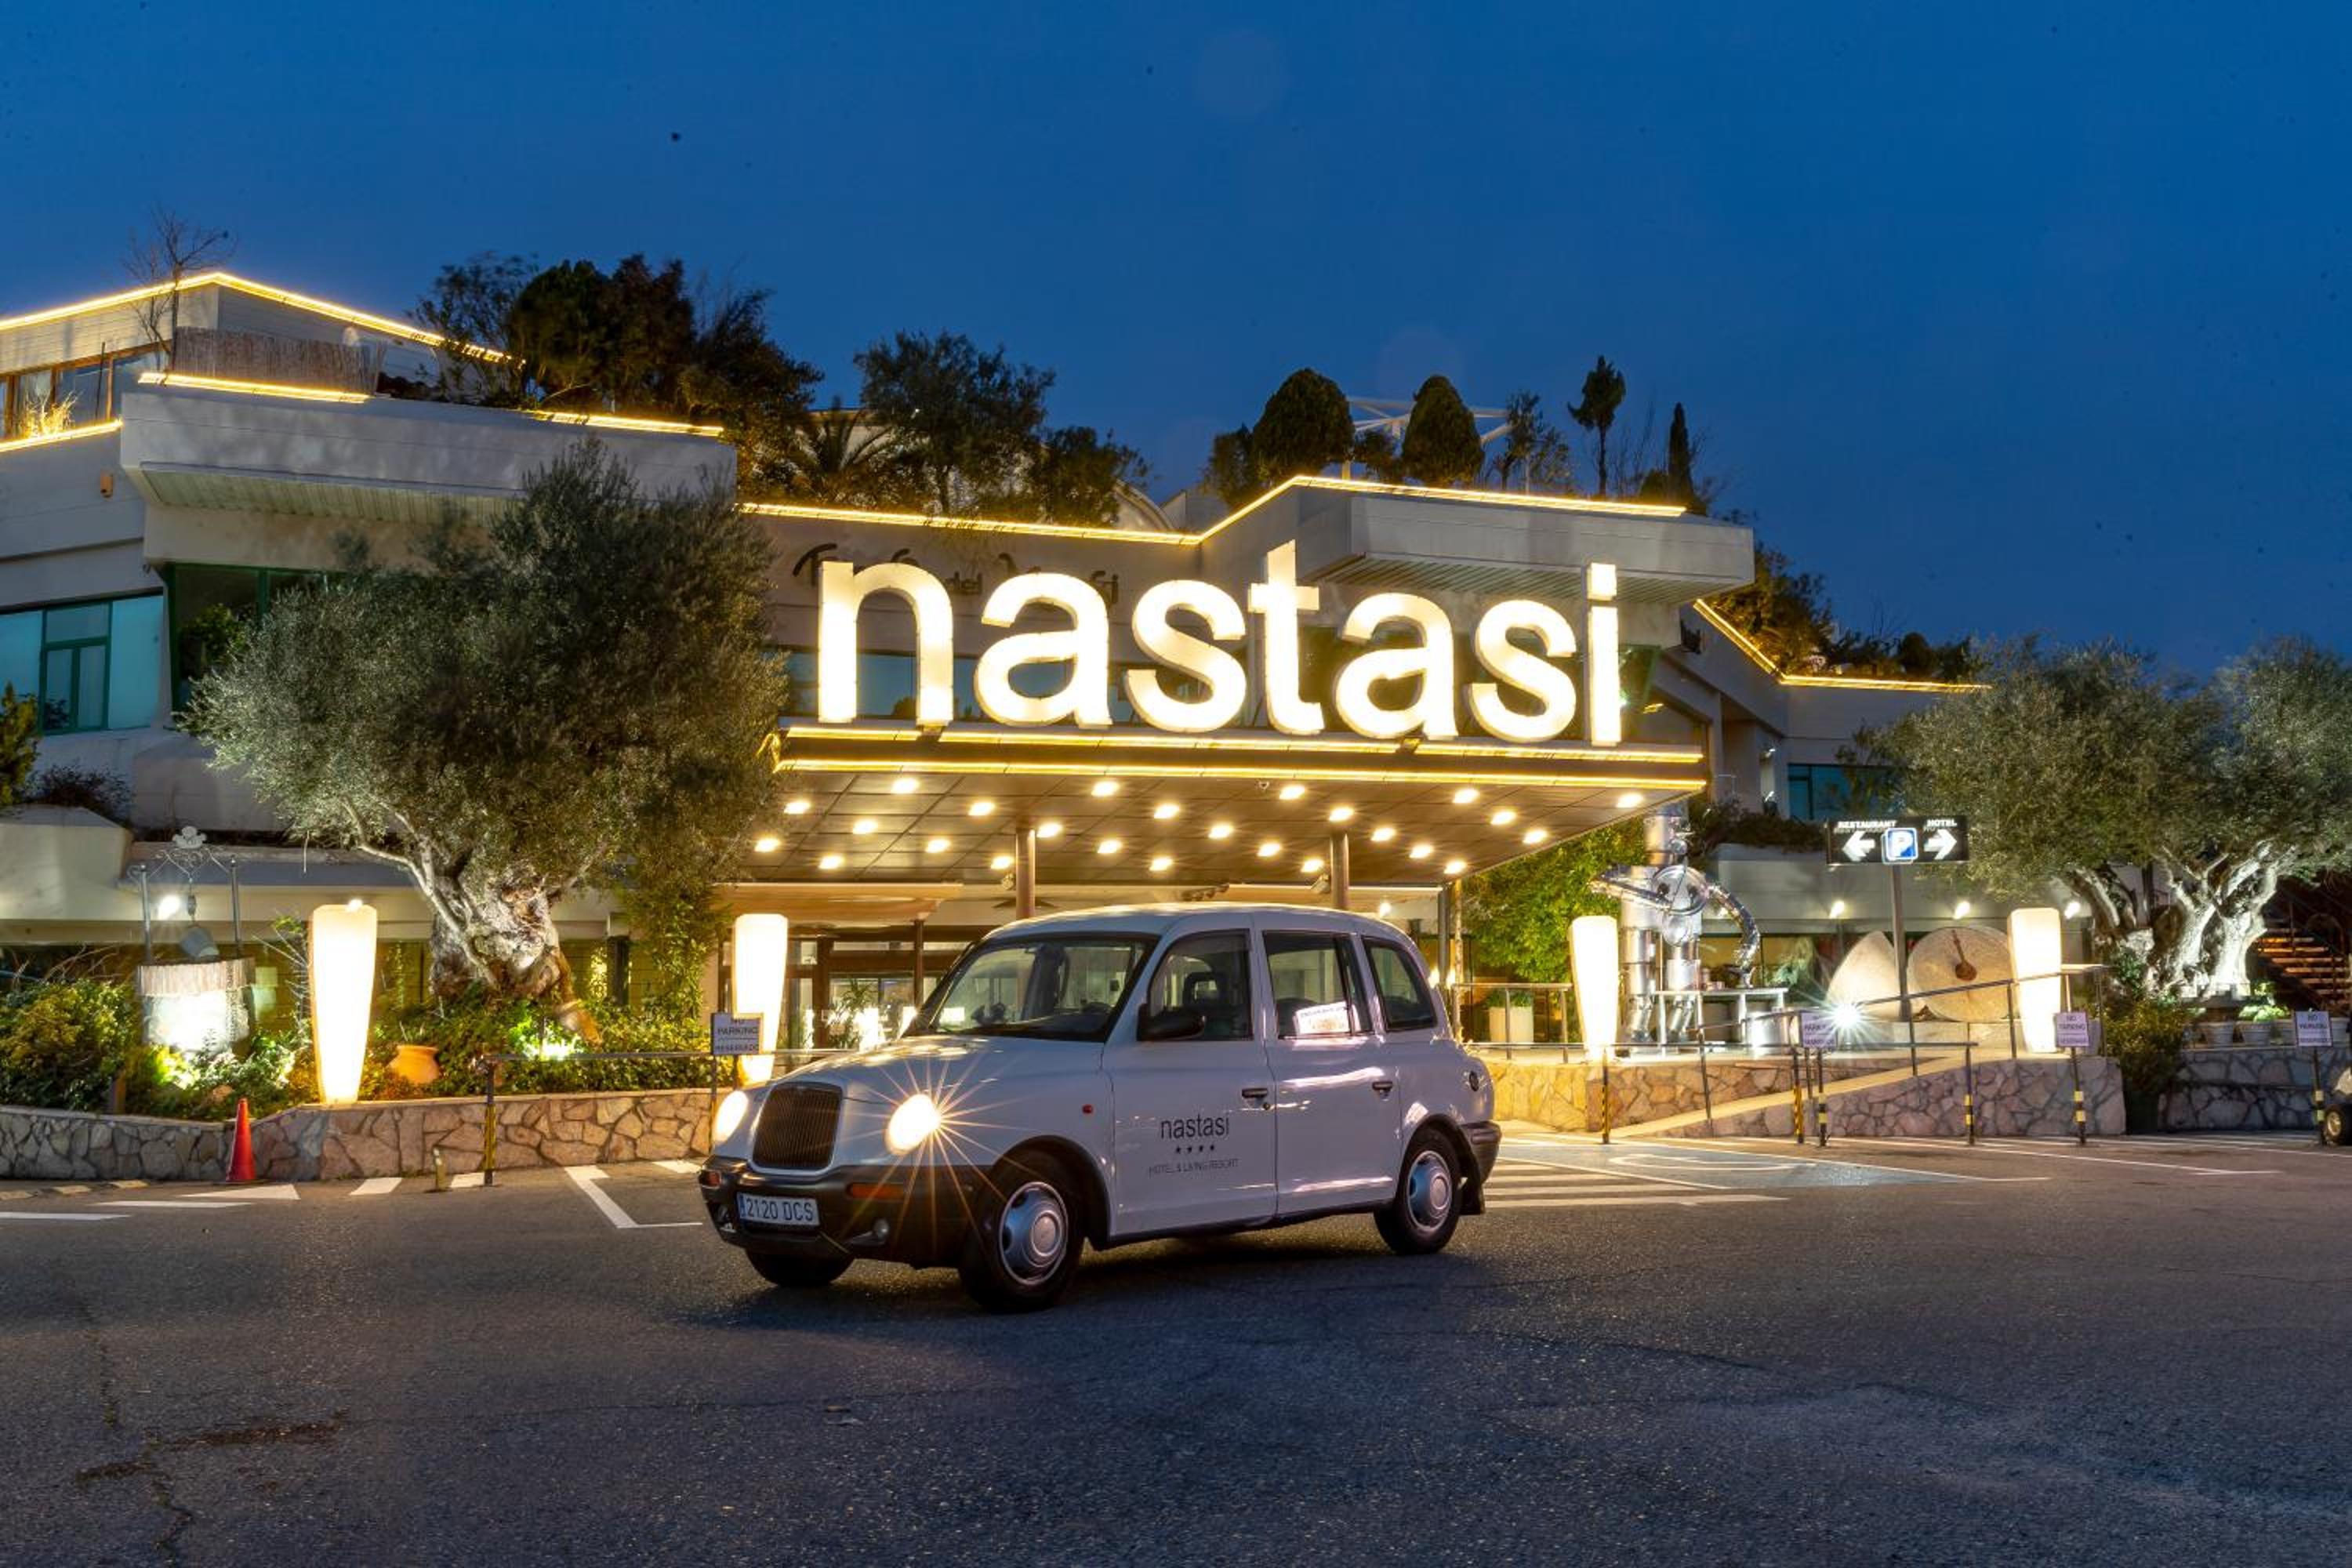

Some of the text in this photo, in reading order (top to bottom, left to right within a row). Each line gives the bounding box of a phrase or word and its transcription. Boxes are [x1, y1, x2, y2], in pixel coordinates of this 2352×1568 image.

[818, 539, 1623, 747] nastasi
[1837, 819, 1897, 829] RESTAURANT
[1926, 818, 1958, 827] HOTEL
[717, 1025, 759, 1035] PARKING
[1160, 1112, 1229, 1139] nastasi
[746, 1197, 814, 1222] 2120 DCS
